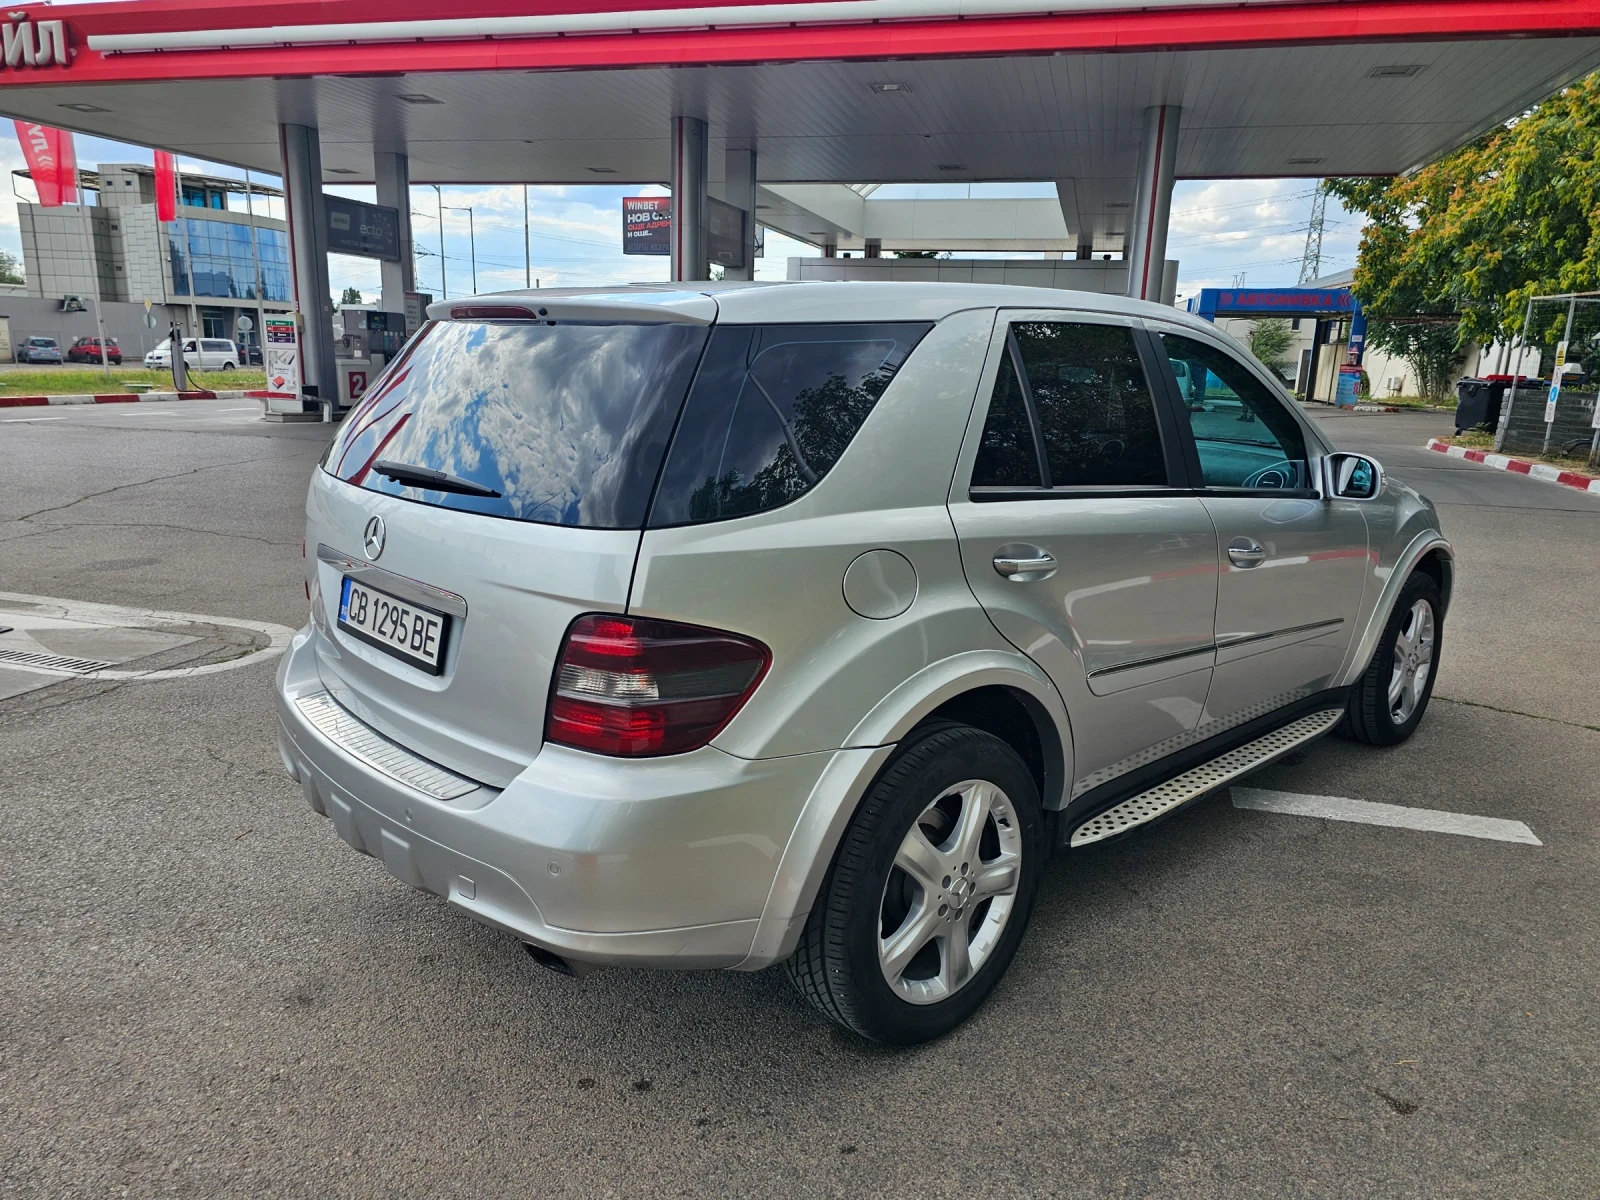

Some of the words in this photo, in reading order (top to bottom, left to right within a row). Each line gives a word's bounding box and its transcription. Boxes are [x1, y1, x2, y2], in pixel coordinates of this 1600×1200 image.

[0, 11, 67, 67] ЙЛ
[627, 201, 659, 210] WINBET
[627, 212, 651, 223] НОВ
[360, 224, 383, 238] ecto
[646, 220, 671, 229] АДРЕН
[1236, 293, 1332, 306] АВТОМИВКА
[352, 375, 365, 396] 2
[372, 598, 410, 644] 1295
[410, 614, 438, 659] BE
